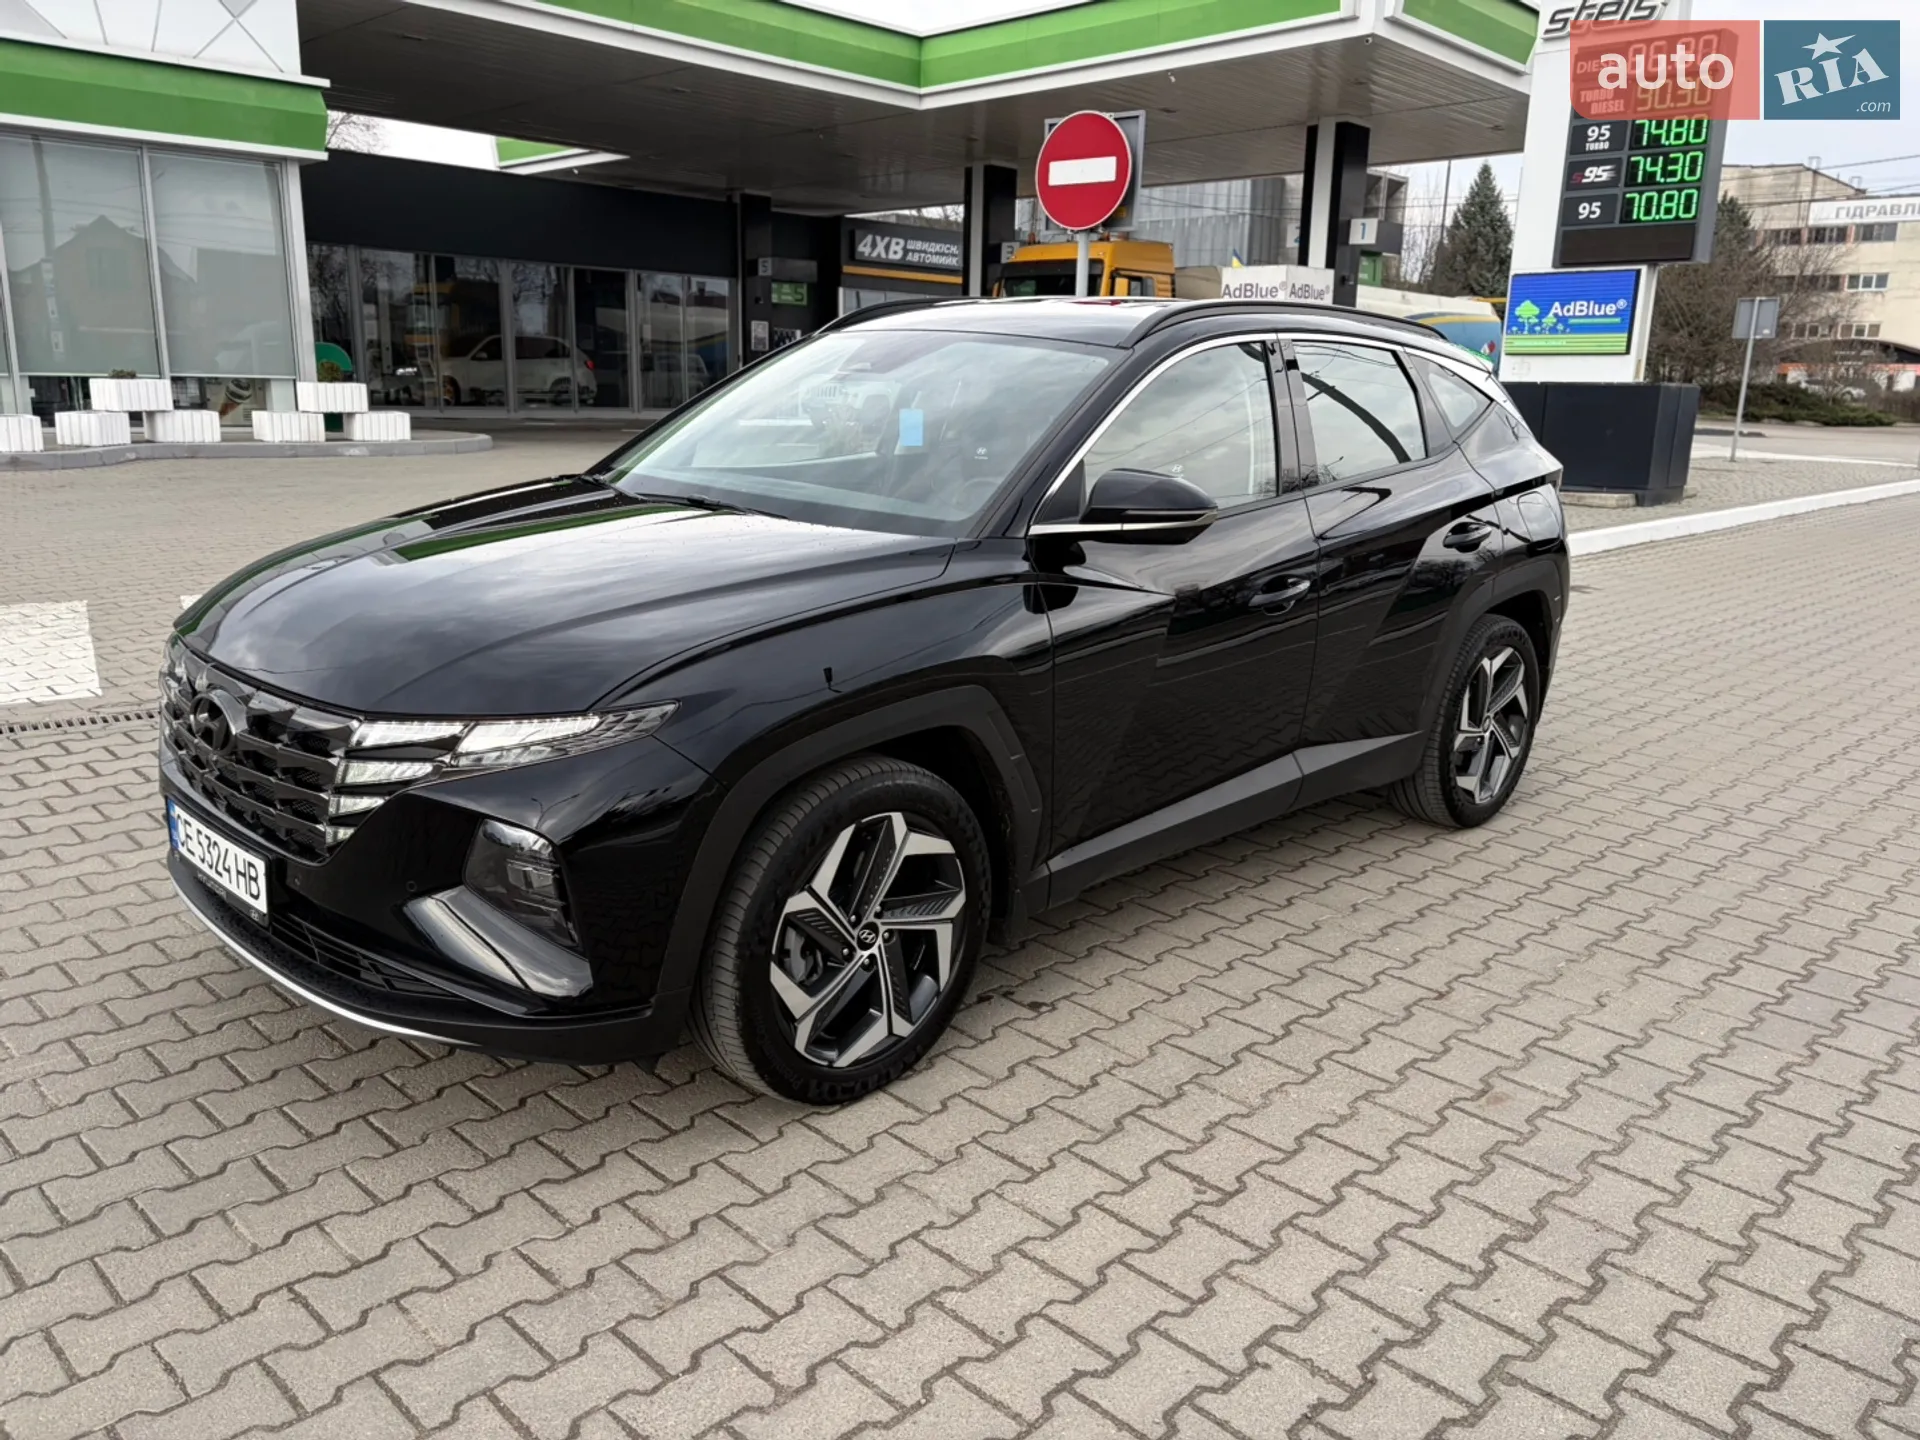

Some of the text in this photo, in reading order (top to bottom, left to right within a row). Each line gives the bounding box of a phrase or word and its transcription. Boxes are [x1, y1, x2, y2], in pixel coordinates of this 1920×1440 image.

[1590, 98, 1625, 114] DIESEL
[1585, 140, 1609, 152] TURBO
[1586, 114, 1708, 147] 95 74.80
[1629, 151, 1704, 184] 74.30
[1578, 188, 1699, 221] 95 70.80
[1834, 202, 1920, 219] ГІДРАВЛ
[196, 828, 232, 884] 5324
[234, 853, 261, 901] HB
